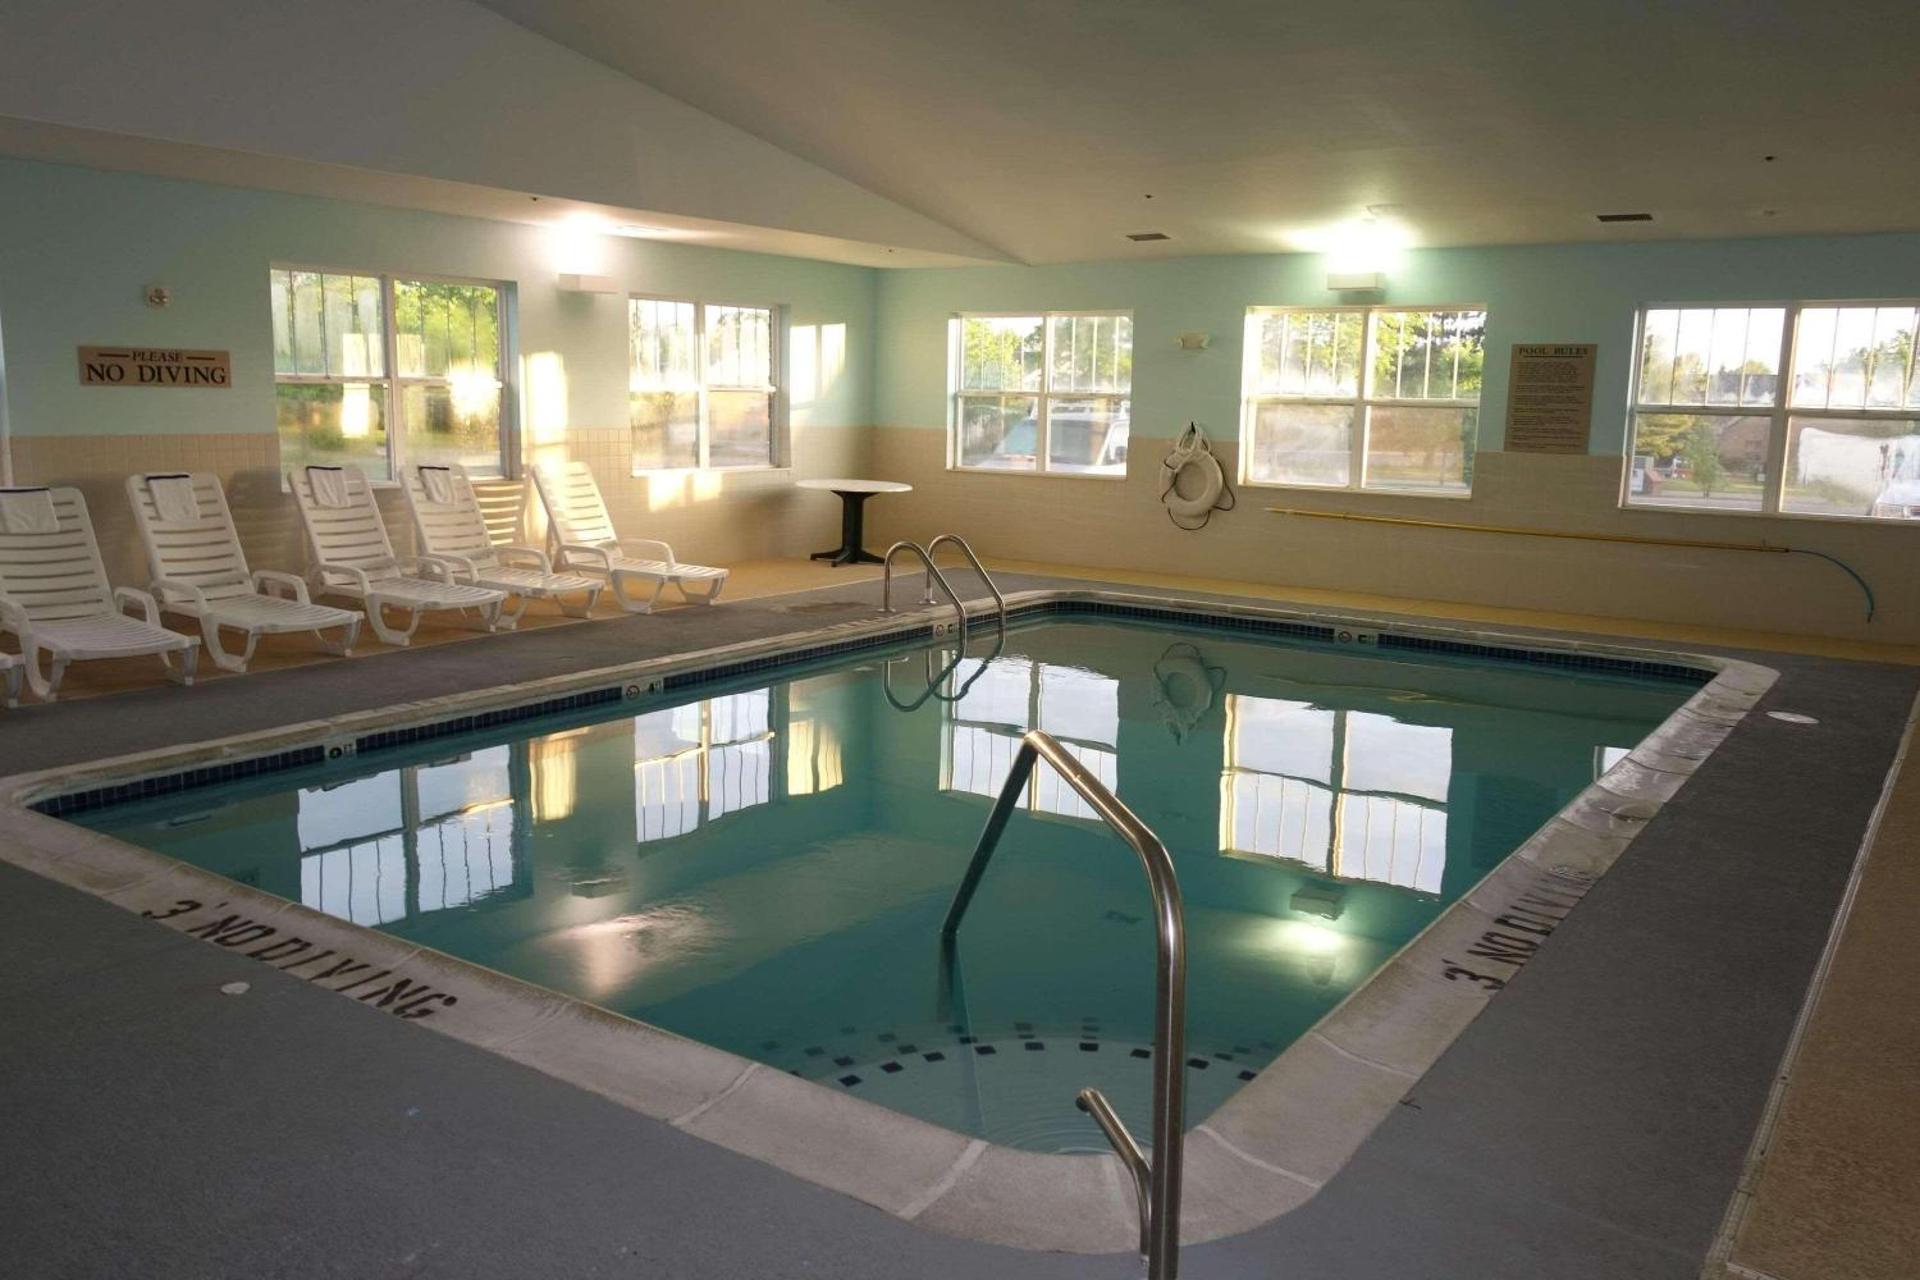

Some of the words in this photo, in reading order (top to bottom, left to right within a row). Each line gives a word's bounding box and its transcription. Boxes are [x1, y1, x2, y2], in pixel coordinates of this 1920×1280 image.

[132, 351, 181, 361] PLEASE
[85, 363, 125, 382] NO
[138, 364, 226, 384] DIVING
[1466, 931, 1541, 967] NO
[187, 914, 276, 947] NO
[246, 937, 457, 1019] DIVING
